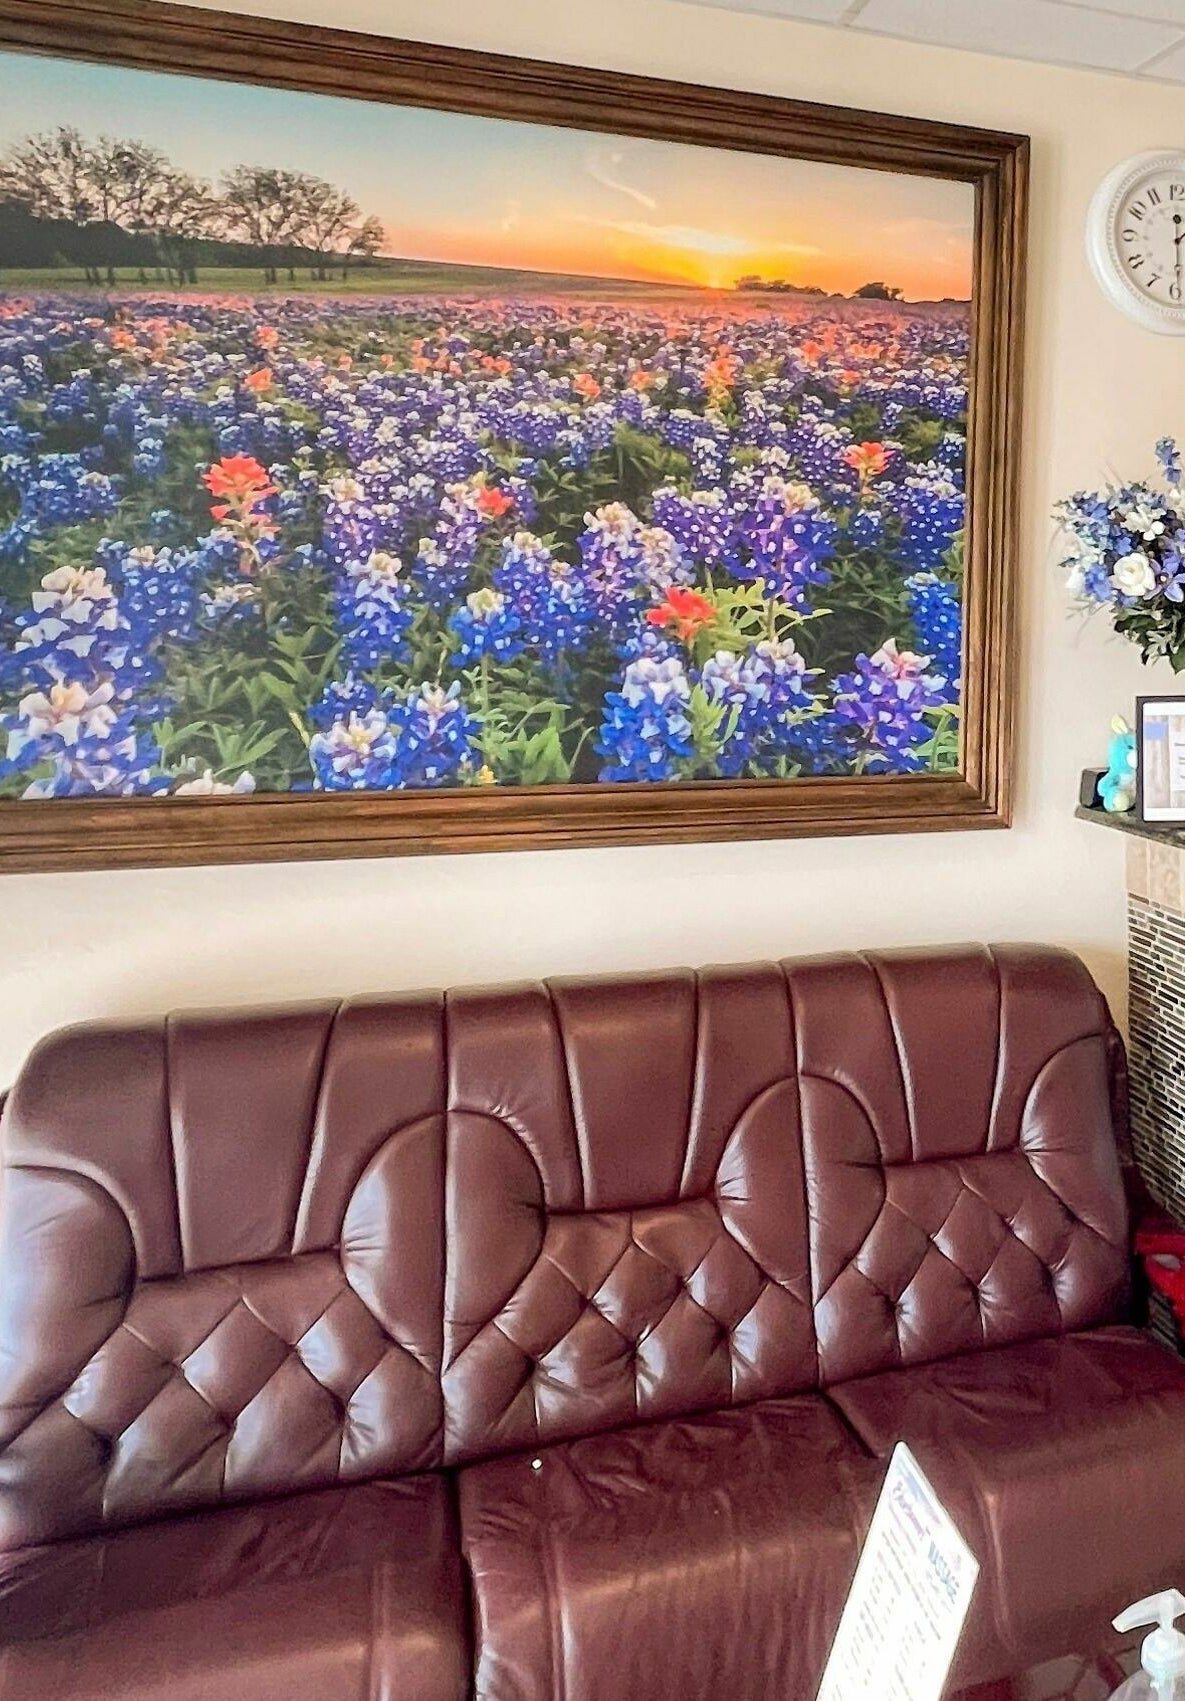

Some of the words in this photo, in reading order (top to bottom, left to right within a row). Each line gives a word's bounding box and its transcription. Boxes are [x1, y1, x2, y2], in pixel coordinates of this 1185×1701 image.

[1146, 188, 1162, 206] 11
[1169, 184, 1185, 201] 12
[1128, 200, 1147, 221] 10
[1122, 229, 1140, 242] 9
[1127, 254, 1145, 270] 8
[1146, 272, 1162, 288] 7
[1169, 282, 1182, 301] 6
